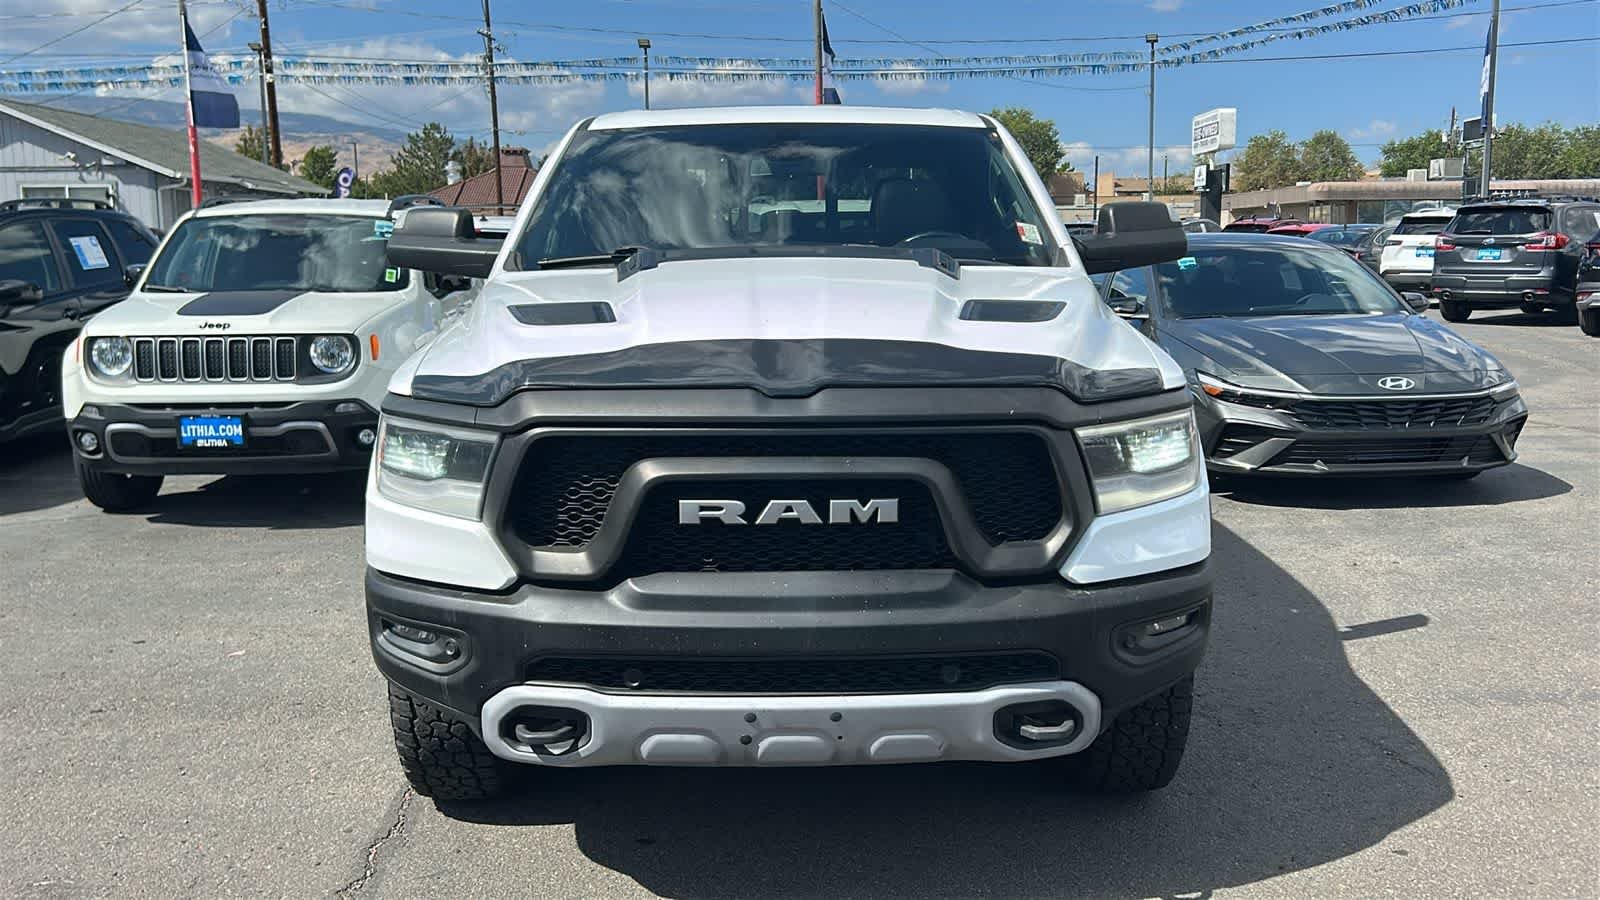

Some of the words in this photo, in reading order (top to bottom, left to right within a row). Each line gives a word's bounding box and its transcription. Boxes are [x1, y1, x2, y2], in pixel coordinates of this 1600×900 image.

[199, 322, 231, 331] Jeep
[181, 424, 242, 437] LITHIA.COM
[679, 499, 898, 524] RAM
